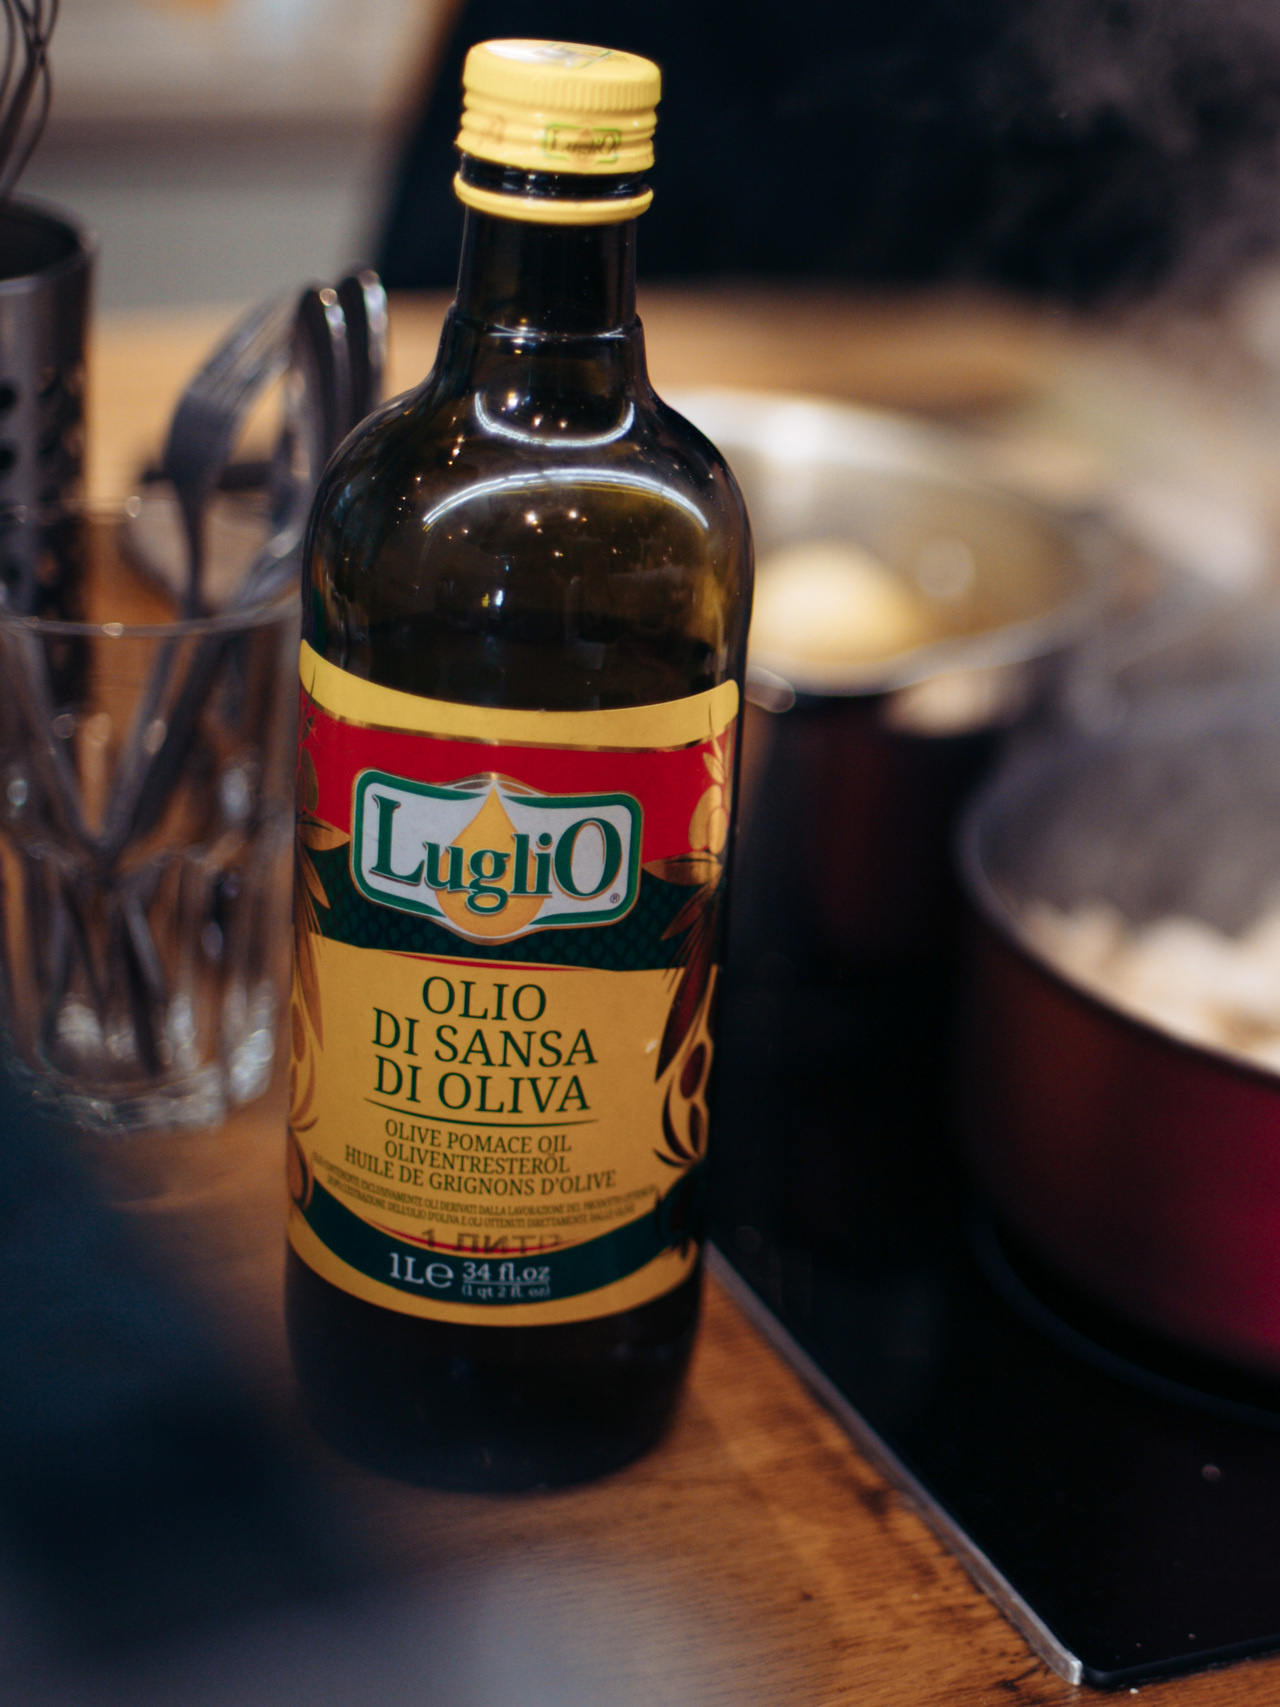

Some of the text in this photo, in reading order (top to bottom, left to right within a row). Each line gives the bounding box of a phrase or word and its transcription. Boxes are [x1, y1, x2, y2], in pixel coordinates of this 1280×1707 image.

[422, 976, 547, 1022] OLIO
[371, 1006, 599, 1068] DI SANSA
[374, 1054, 591, 1114] DI OLIVA
[385, 1118, 572, 1154] OLIVE POMACE OIL
[385, 1140, 570, 1175] OLIVENTRESTERÖL
[345, 1143, 395, 1180] HUILE
[400, 1164, 424, 1187] DE
[429, 1172, 535, 1196] GRIGNONS
[541, 1169, 617, 1196] D'OLIVE
[462, 1261, 491, 1280] 34
